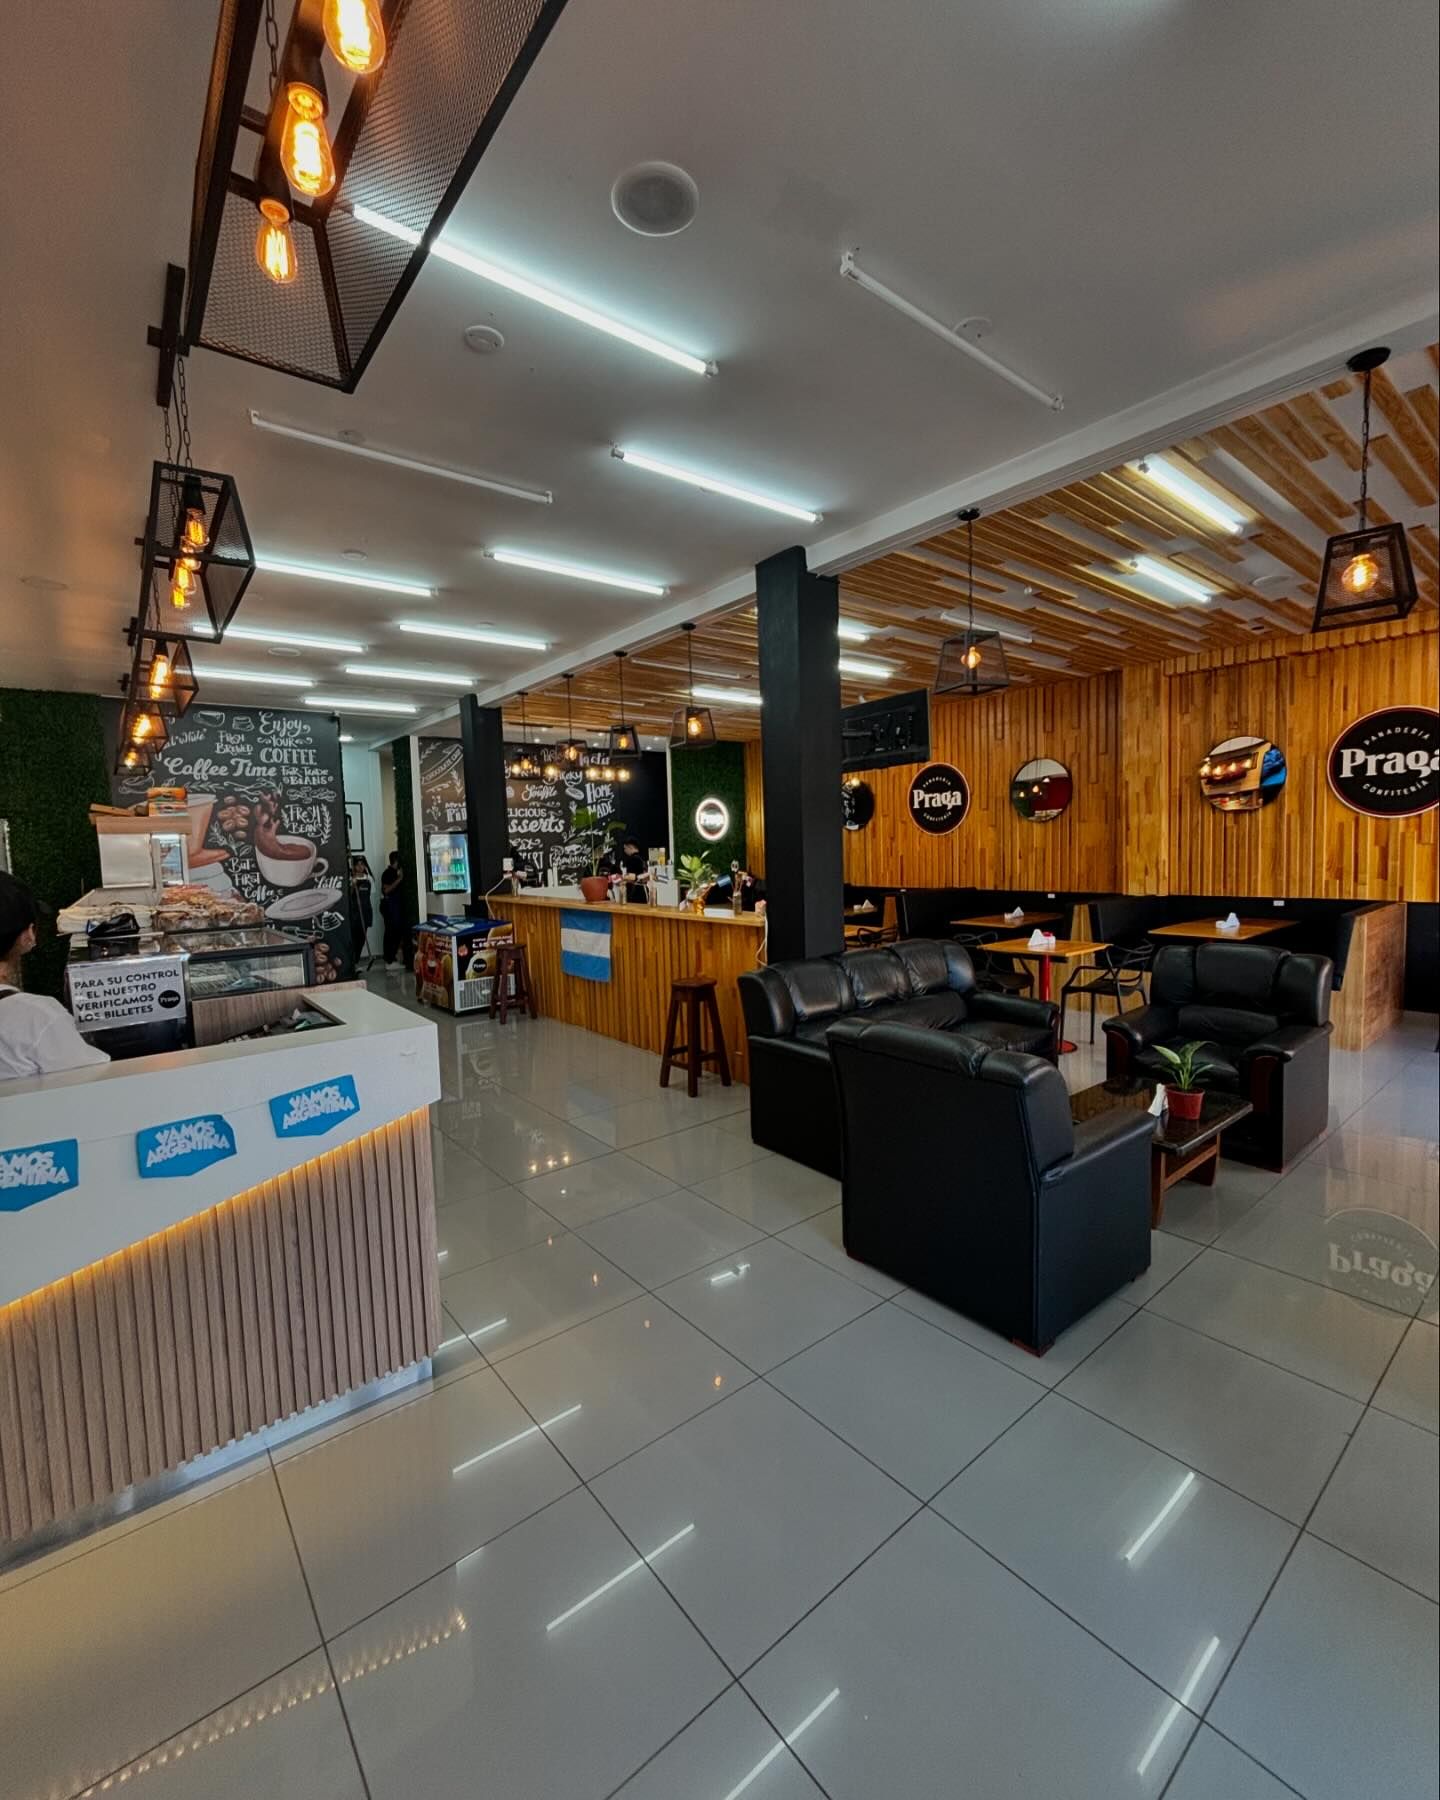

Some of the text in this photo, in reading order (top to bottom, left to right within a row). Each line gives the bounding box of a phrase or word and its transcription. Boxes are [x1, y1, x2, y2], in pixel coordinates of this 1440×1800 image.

[259, 711, 311, 736] Enjoy
[260, 748, 317, 765] COFFEE
[164, 757, 229, 780] Coffee
[230, 758, 277, 777] Time
[912, 789, 962, 810] Praga
[74, 969, 179, 989] PARA SU CONTROL
[86, 990, 101, 1000] EL
[103, 982, 157, 997] NUESTRO
[75, 993, 155, 1012] VERIFICAMOS
[104, 1004, 154, 1020] BILLETES
[289, 1085, 339, 1108] VAMOS
[282, 1096, 355, 1130] ARGENTINA
[155, 1120, 216, 1145] VAMOS
[146, 1134, 231, 1169] ARGENTINA
